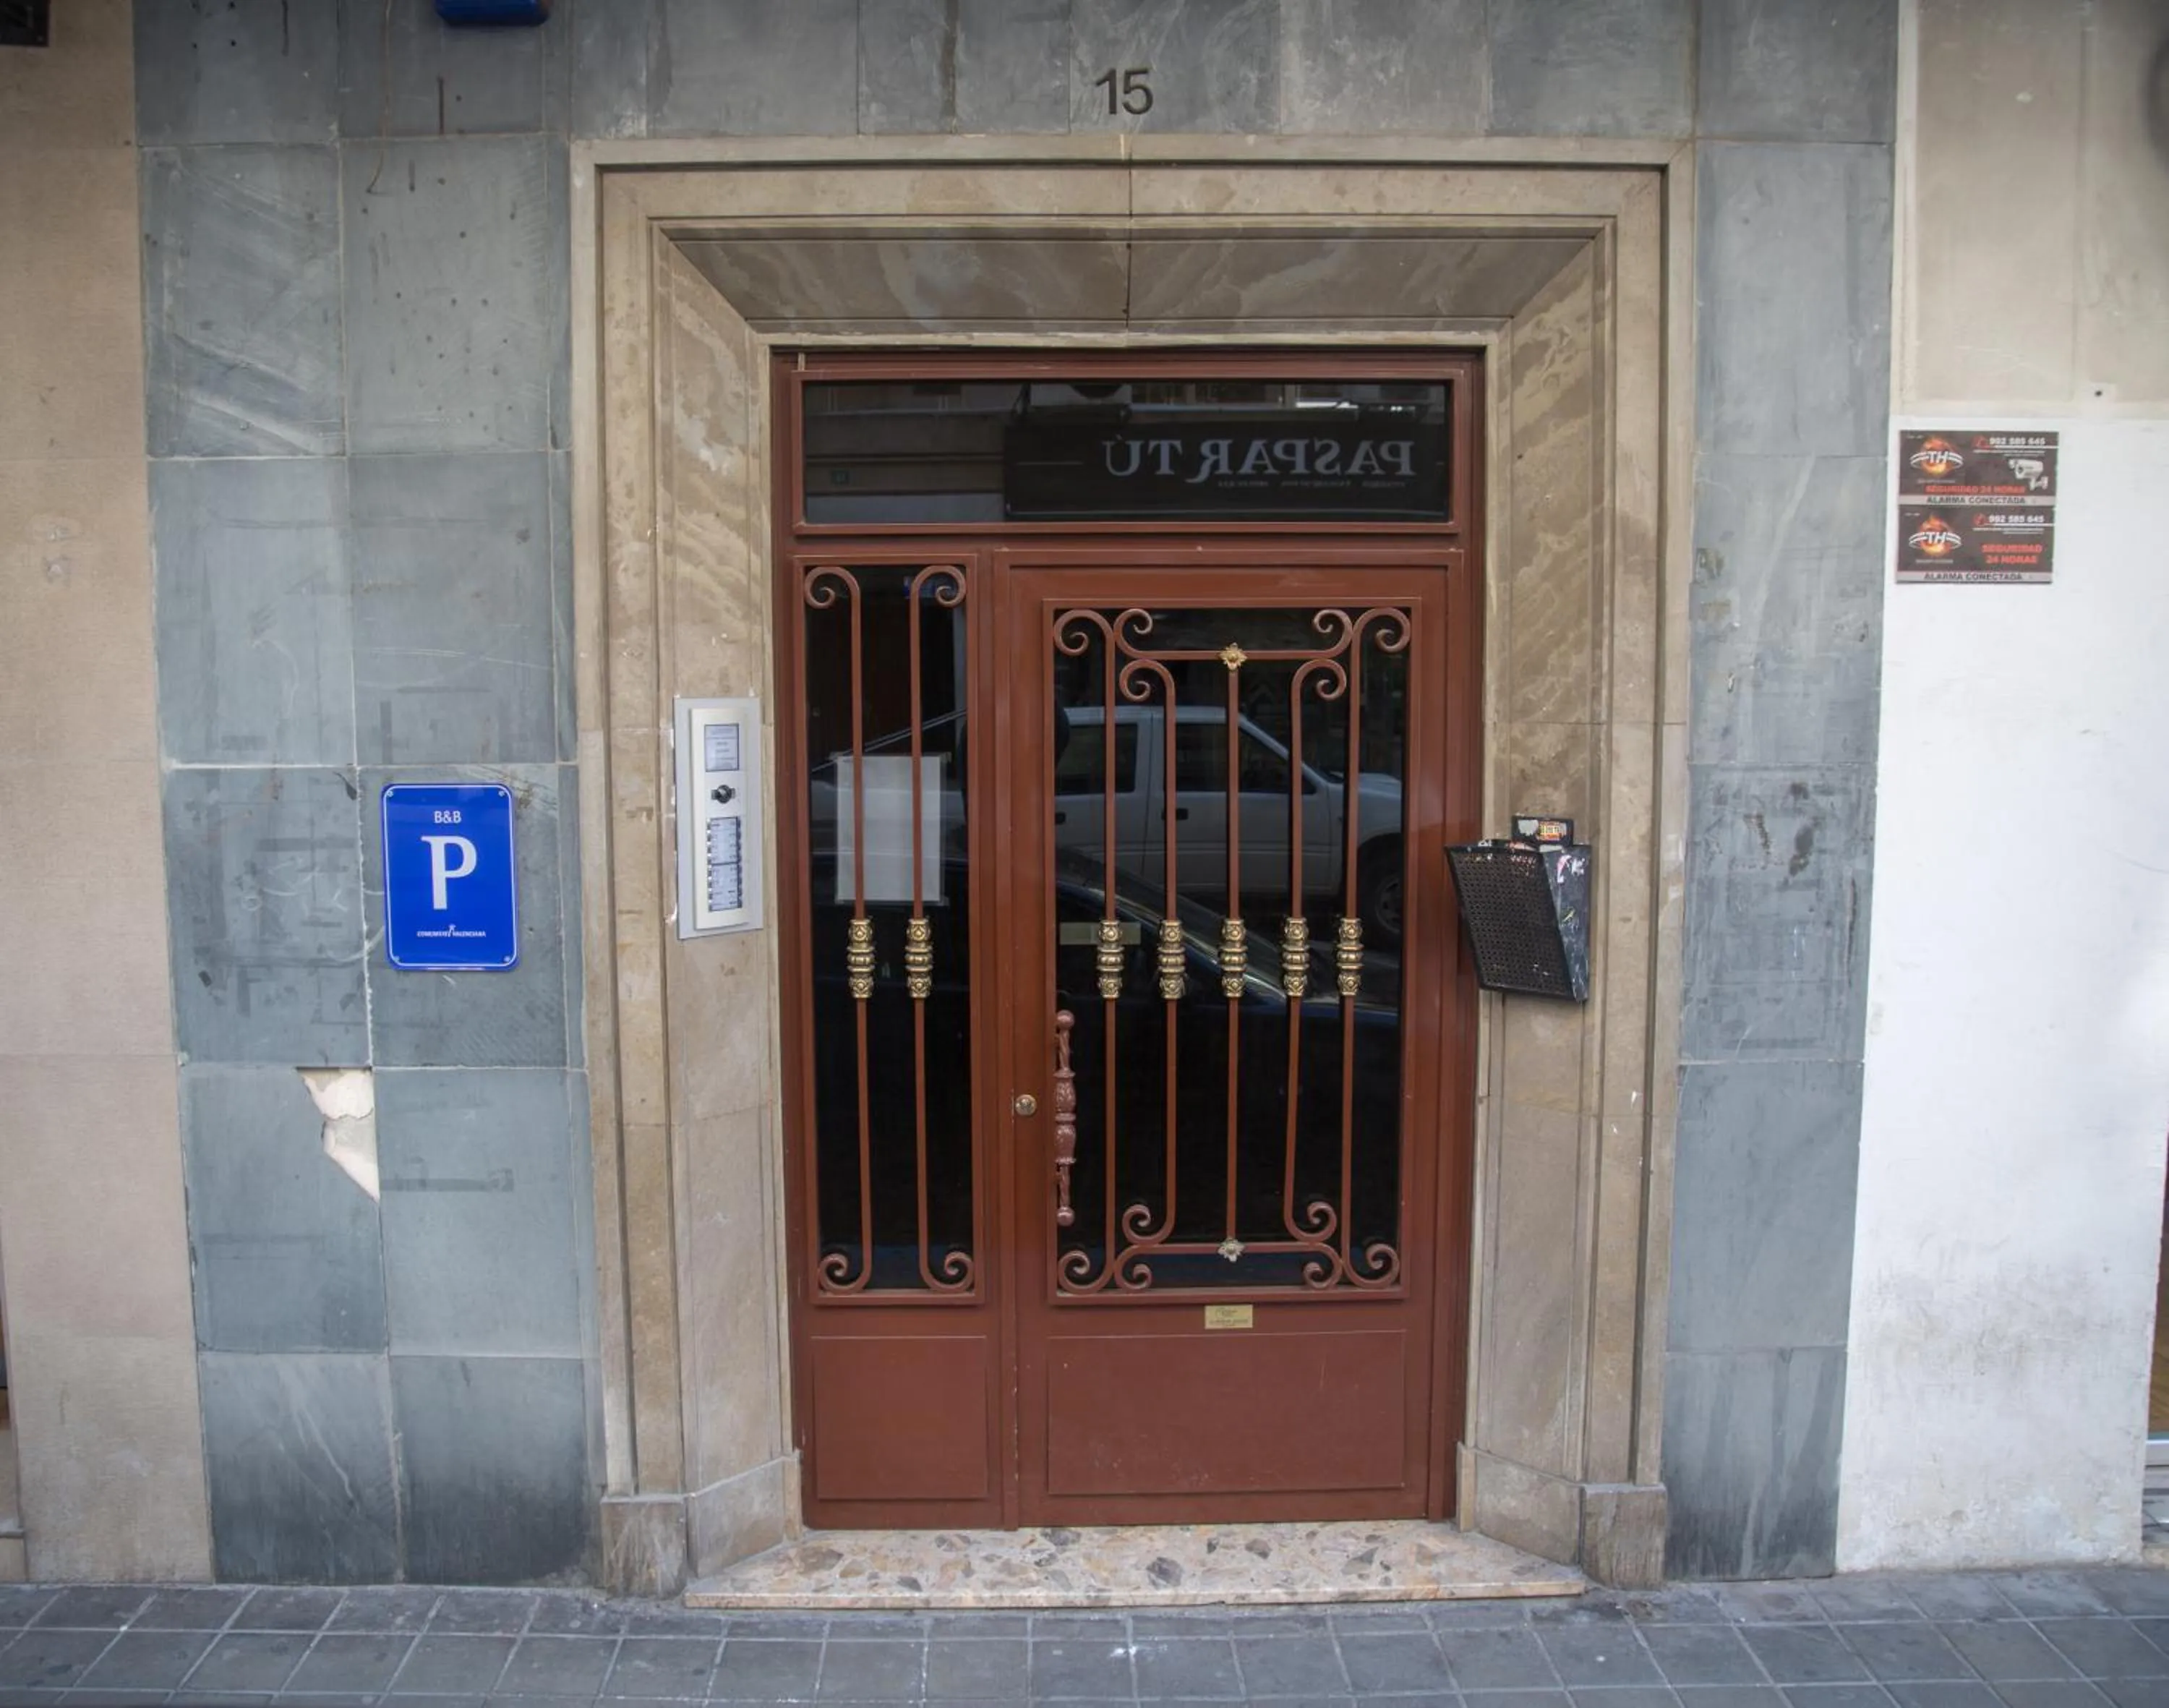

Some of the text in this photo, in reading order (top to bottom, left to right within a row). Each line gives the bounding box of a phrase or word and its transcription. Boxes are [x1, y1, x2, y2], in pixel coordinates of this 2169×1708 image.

[1095, 68, 1153, 115] 15
[1982, 544, 2042, 553] SEGURIDAD
[1986, 555, 2038, 565] 24 HORAS
[1924, 572, 2023, 581] ALARMA CONECTADA
[434, 811, 462, 824] B&B
[420, 835, 477, 910] P
